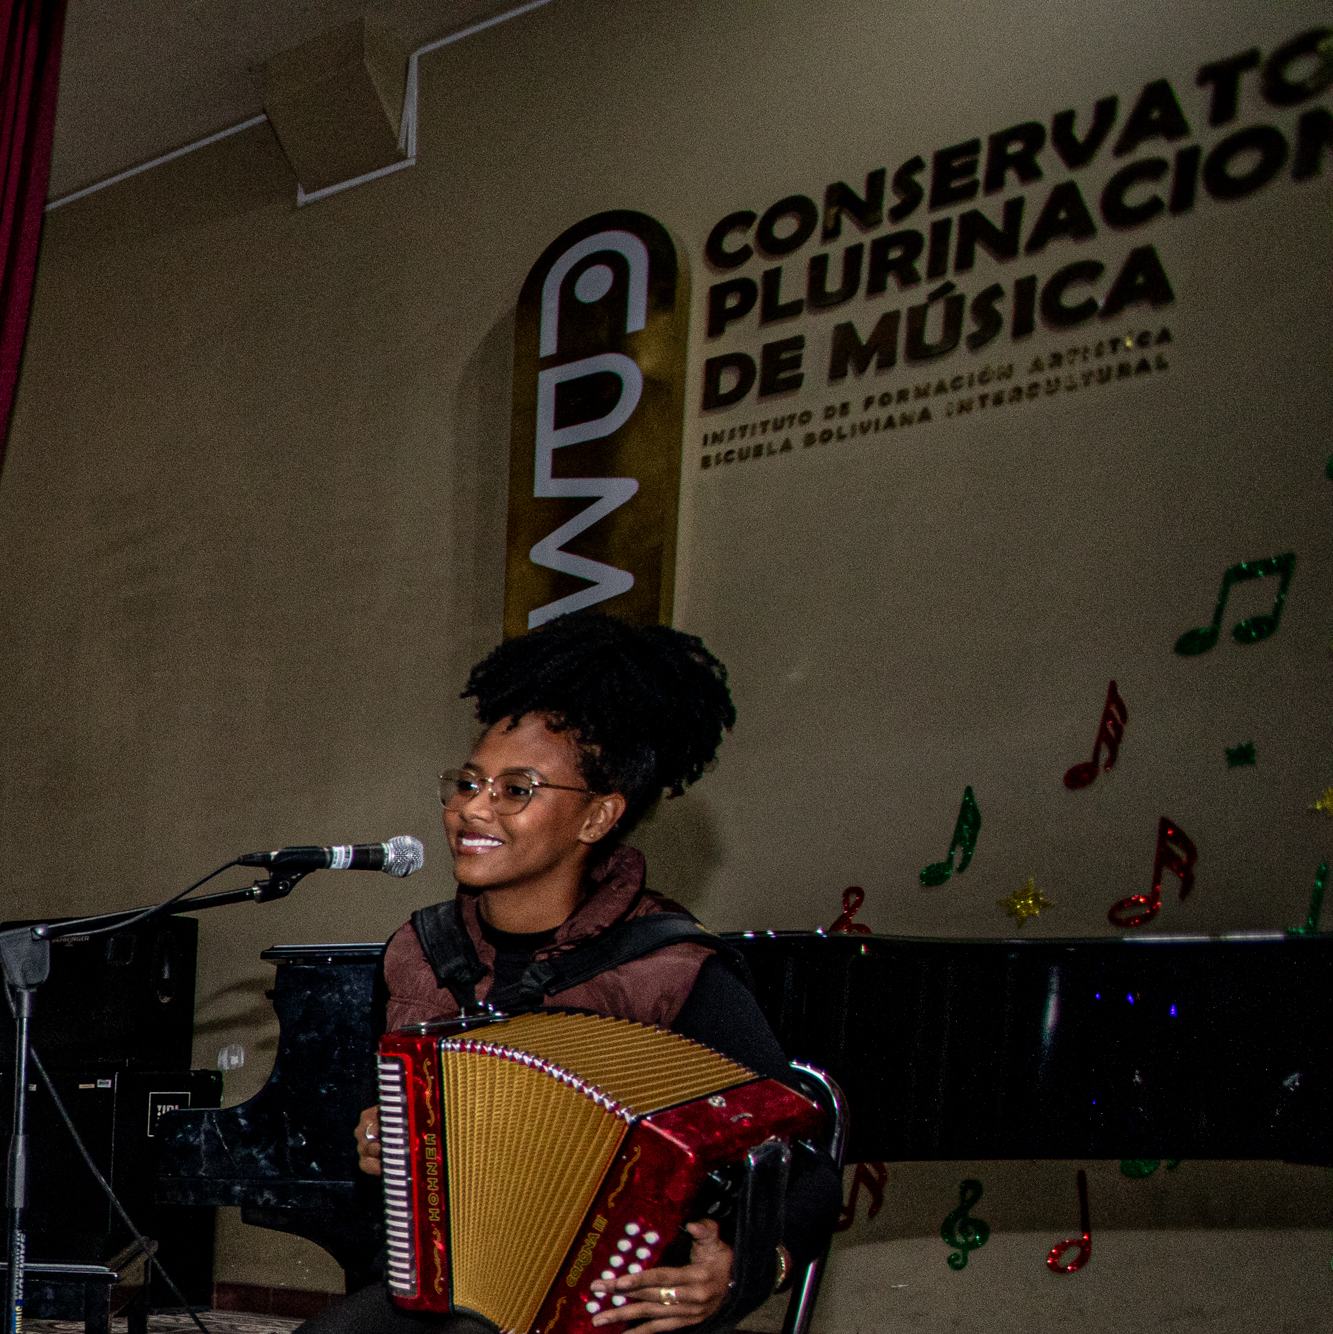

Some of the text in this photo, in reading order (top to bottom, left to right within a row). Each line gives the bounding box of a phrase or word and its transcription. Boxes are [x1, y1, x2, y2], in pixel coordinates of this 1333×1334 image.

[700, 243, 1176, 414] DE MÚSICA
[699, 352, 1171, 471] ESCUELA BOLIVIANA INTERCULTURAL
[701, 410, 813, 448] INSTITUTO
[821, 401, 852, 422] DE
[862, 361, 1015, 413] FORMACIÓN
[425, 1133, 441, 1222] HOHNER
[566, 1232, 601, 1287] CORONA
